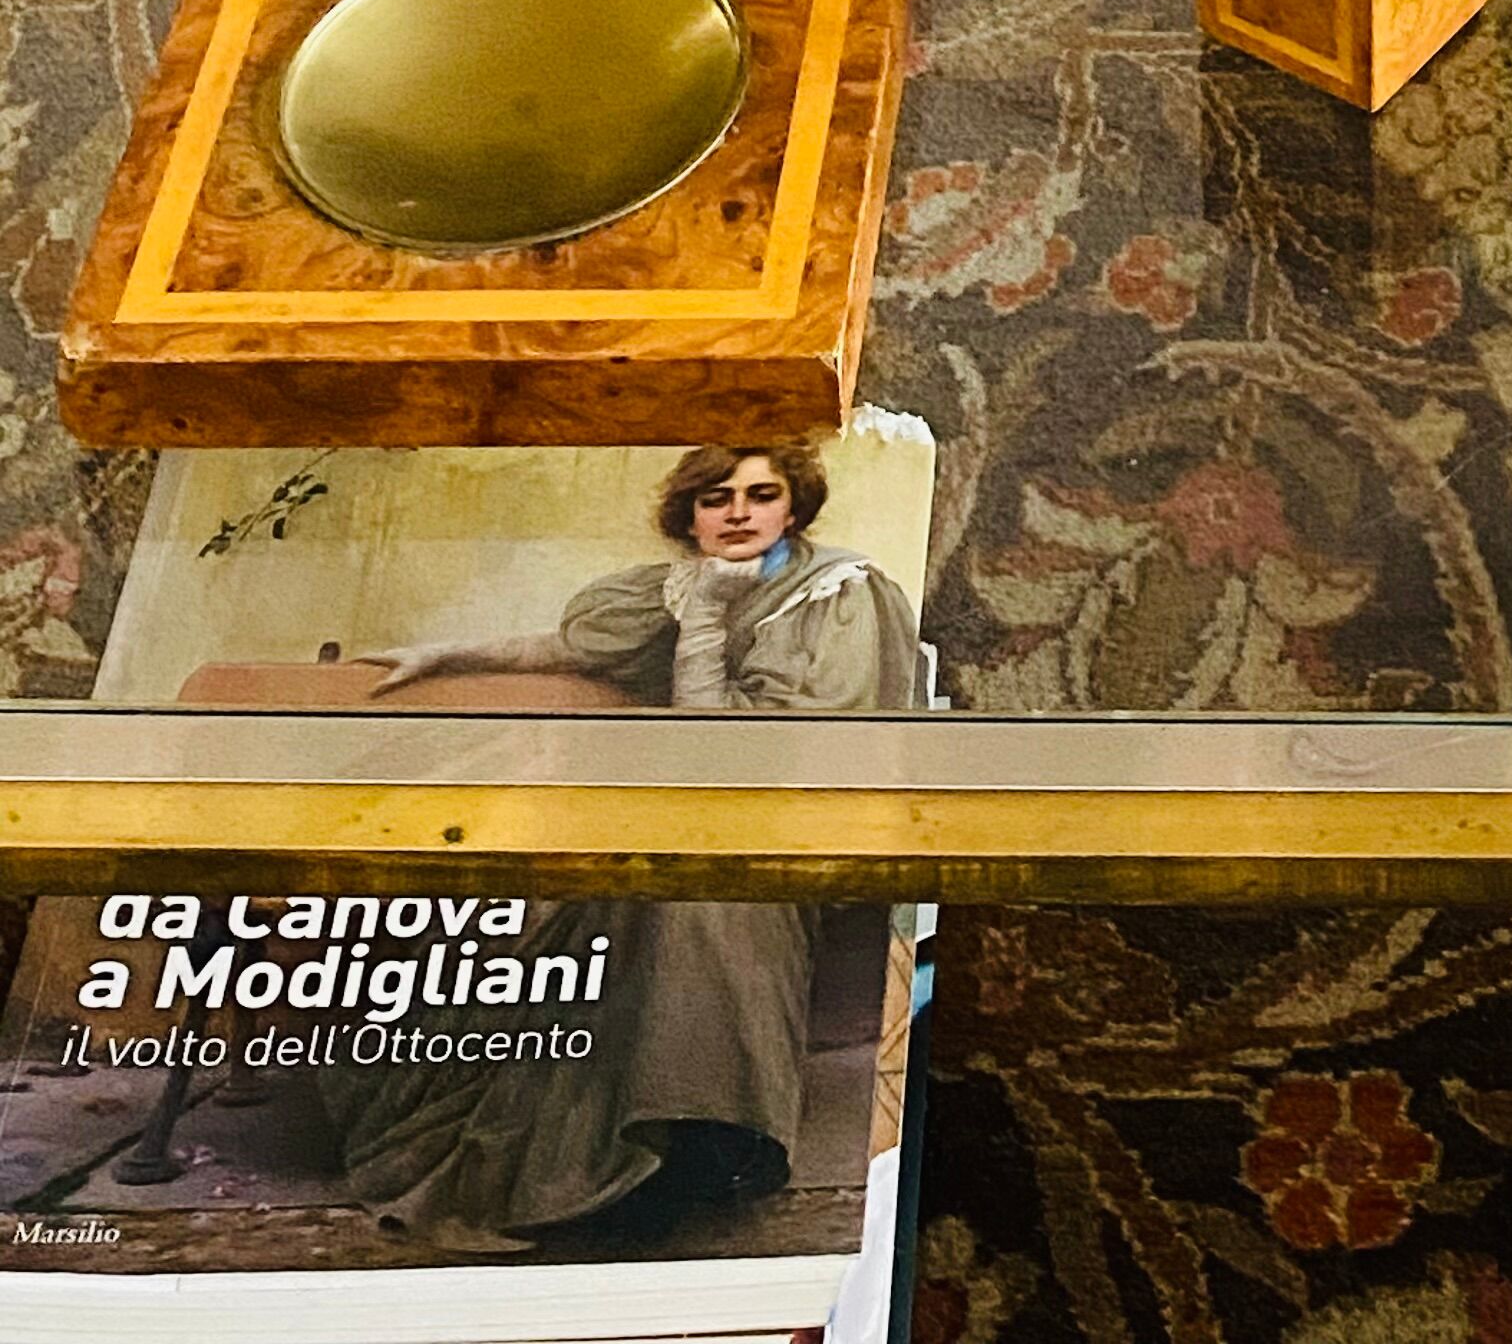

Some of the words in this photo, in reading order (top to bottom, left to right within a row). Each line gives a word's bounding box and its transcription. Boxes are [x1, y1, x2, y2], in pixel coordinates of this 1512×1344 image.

[98, 894, 202, 940] da
[78, 959, 130, 1010] a
[154, 935, 611, 1023] Modigliani
[60, 1025, 91, 1069] il
[107, 1024, 228, 1068] volto
[11, 1219, 121, 1246] Marsilio
